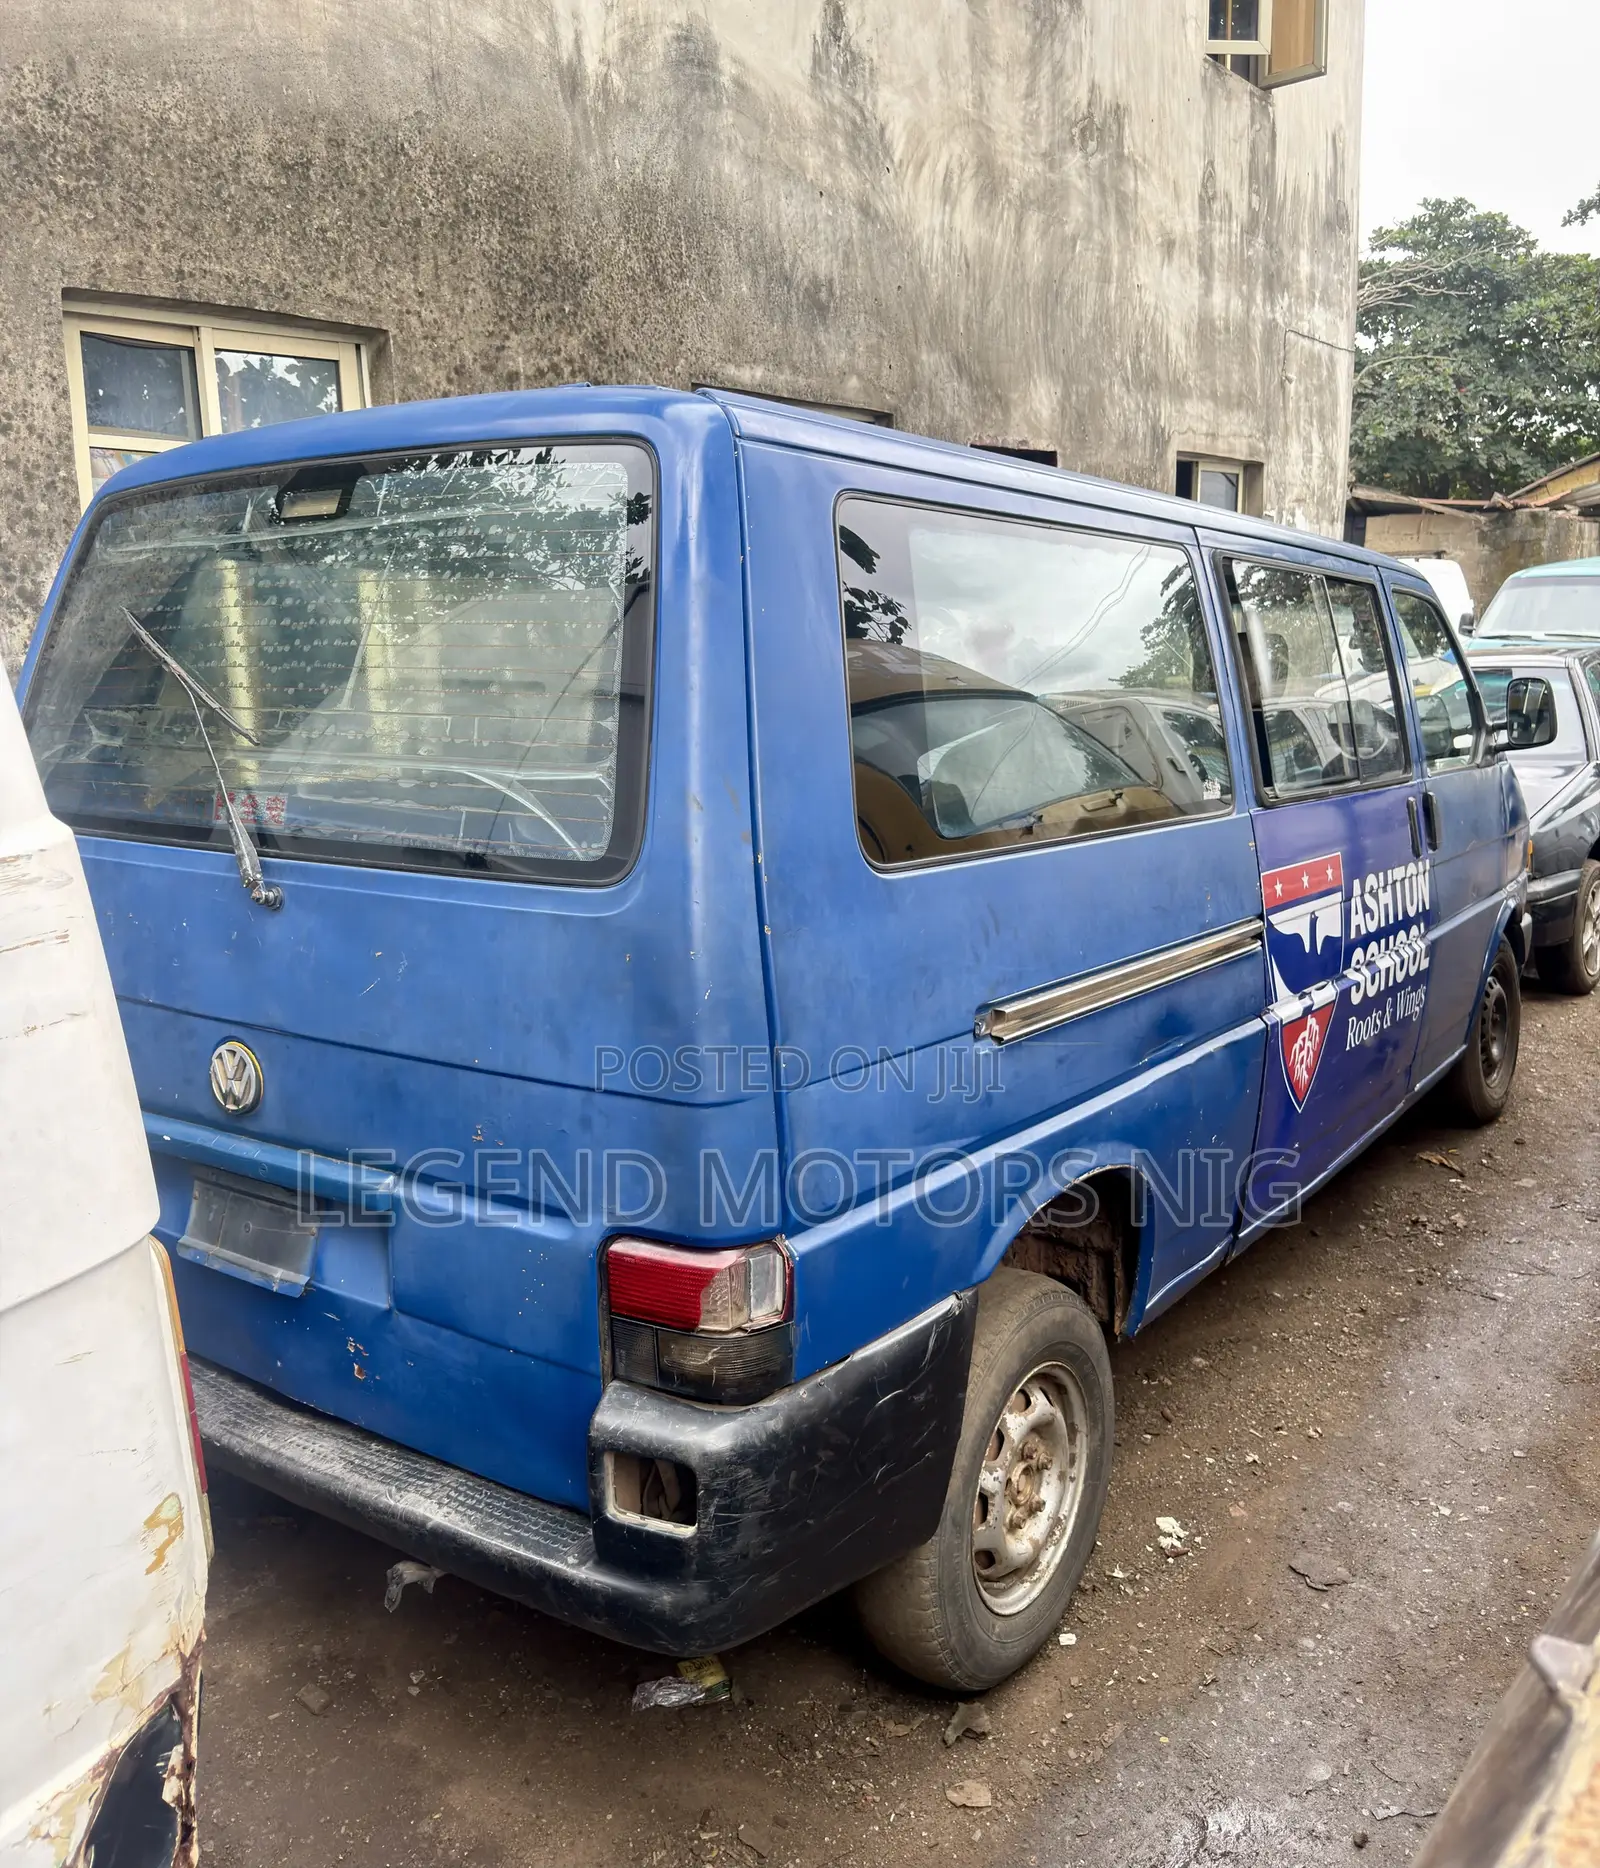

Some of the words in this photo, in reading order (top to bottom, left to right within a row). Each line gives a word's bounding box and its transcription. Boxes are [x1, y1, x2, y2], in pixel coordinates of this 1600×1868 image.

[1350, 859, 1430, 940] ASHTON
[1350, 923, 1430, 1005] SCHOOL
[1346, 1010, 1381, 1051] Roots
[1383, 1003, 1393, 1028] &
[210, 1042, 259, 1111] VW
